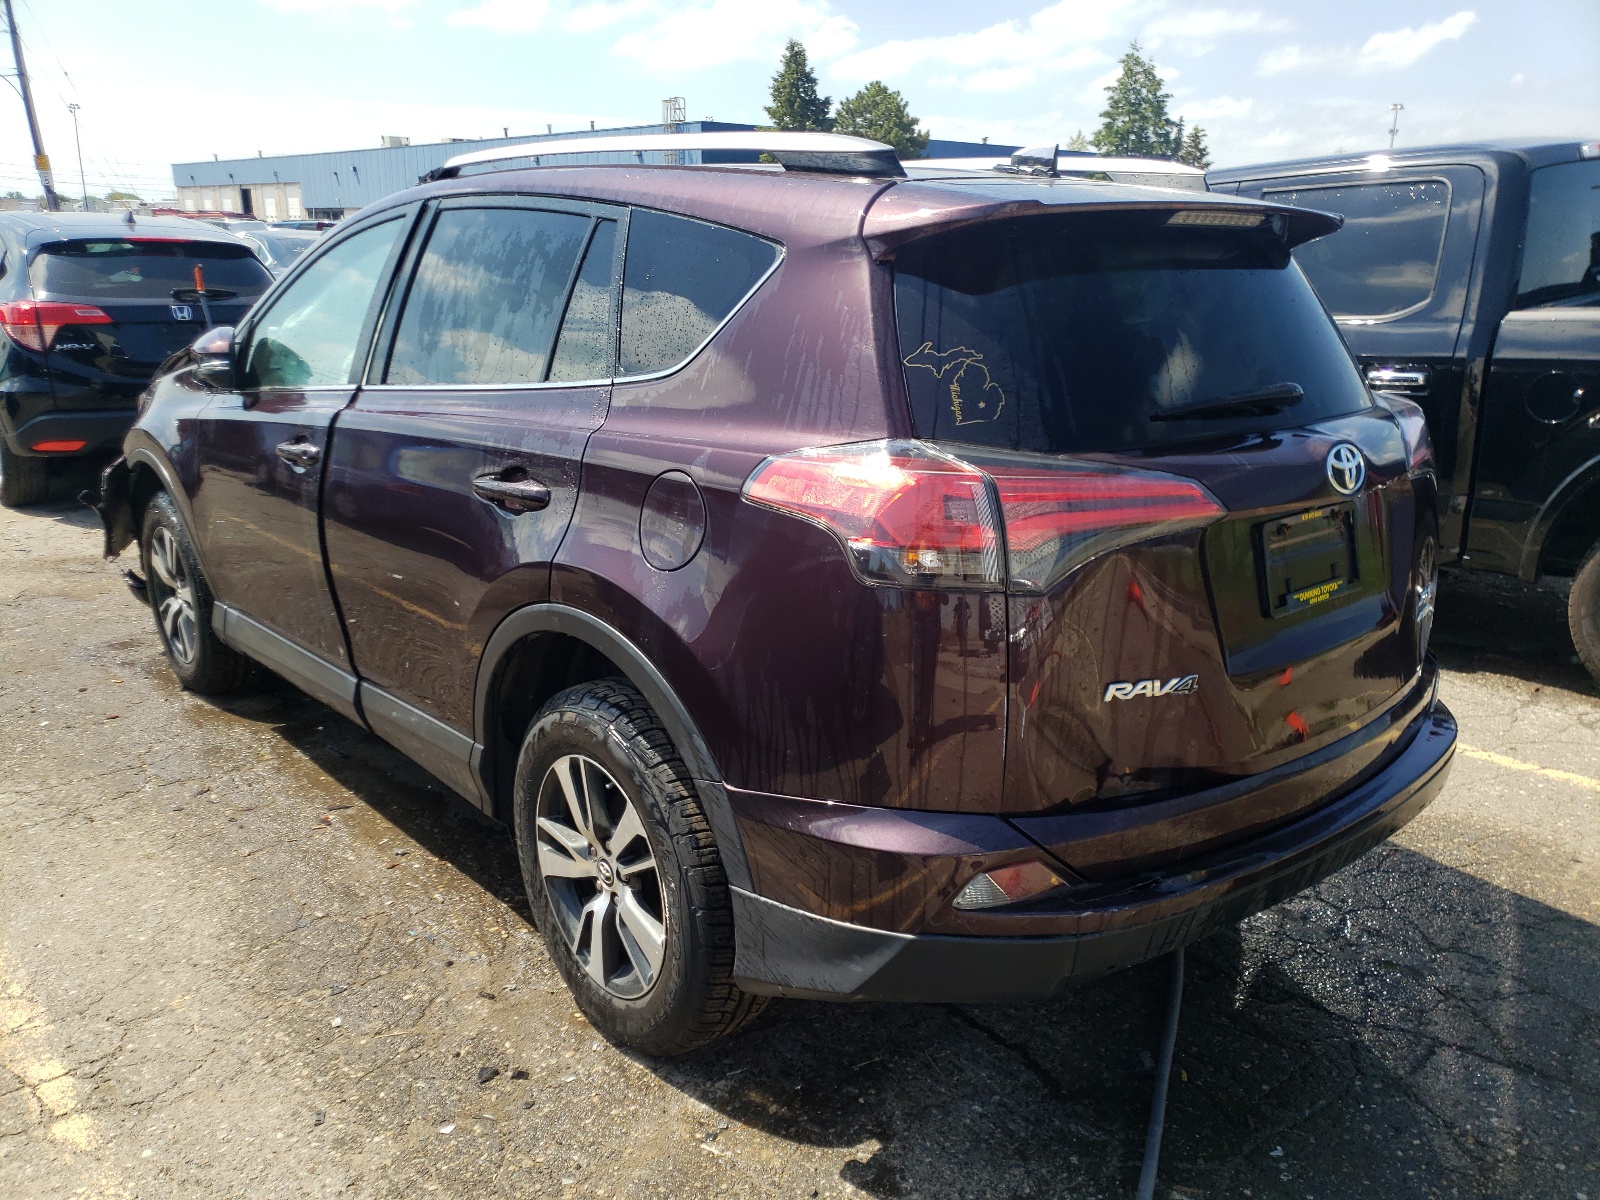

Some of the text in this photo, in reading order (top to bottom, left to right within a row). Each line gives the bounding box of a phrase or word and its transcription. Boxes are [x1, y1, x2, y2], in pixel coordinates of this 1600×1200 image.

[949, 382, 964, 420] Michigan
[1321, 582, 1339, 593] TOYOTA
[1103, 674, 1199, 703] RAV4
